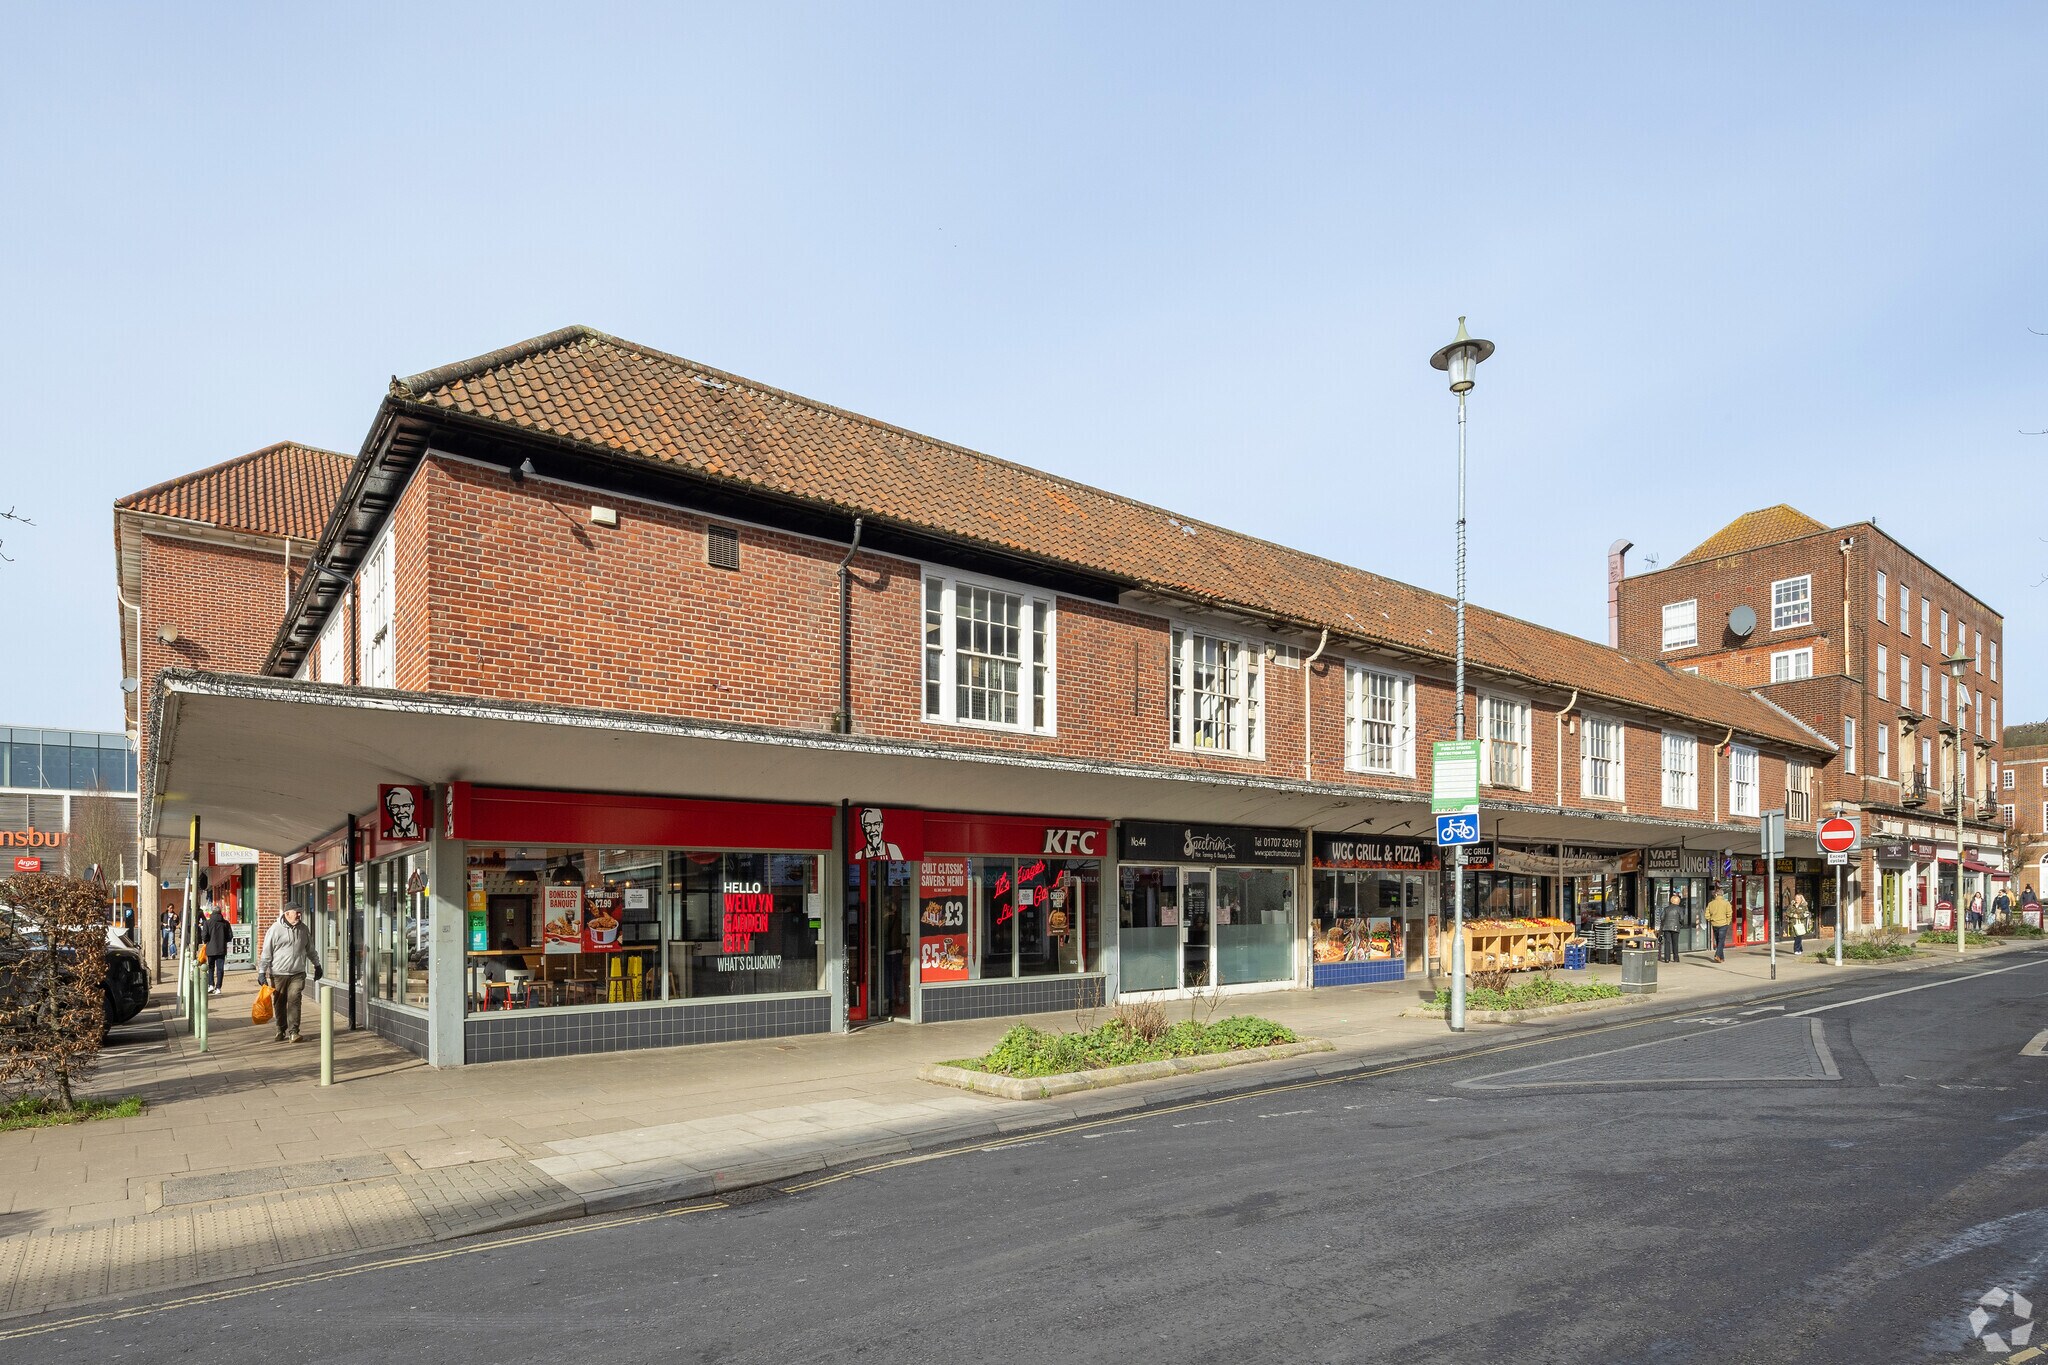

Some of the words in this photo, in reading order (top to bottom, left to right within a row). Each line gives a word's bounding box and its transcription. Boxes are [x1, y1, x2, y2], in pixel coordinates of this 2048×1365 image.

[1043, 829, 1096, 855] KFC
[1184, 829, 1228, 859] Spectrum
[1263, 837, 1281, 847] 01707
[1281, 838, 1302, 848] 324191
[220, 850, 254, 858] BROKERS
[1332, 842, 1354, 861] WGC
[1356, 844, 1382, 861] GRILL
[1384, 845, 1393, 861] &
[1395, 845, 1420, 863] PIZZA
[1473, 847, 1491, 855] GRILL
[1650, 849, 1677, 859] VAPE
[1469, 856, 1488, 864] PIZZA
[1648, 860, 1679, 868] JUNGLE
[922, 863, 937, 875] CULT
[938, 863, 964, 875] CLASSIC
[922, 875, 945, 887] SAVERS
[947, 875, 964, 887] MENU
[723, 882, 761, 893] HELLO
[549, 890, 578, 899] BONELESS
[604, 891, 620, 899] FILLETS
[550, 900, 577, 908] BANQUET
[595, 899, 612, 908] £7.99
[723, 893, 775, 913] WELWYN
[945, 901, 963, 926] £3
[723, 913, 769, 933] GARDEN
[723, 933, 752, 954] CITY
[922, 943, 940, 969] £5
[717, 956, 745, 972] WHAT'S
[746, 955, 782, 970] CLUCKIN'?
